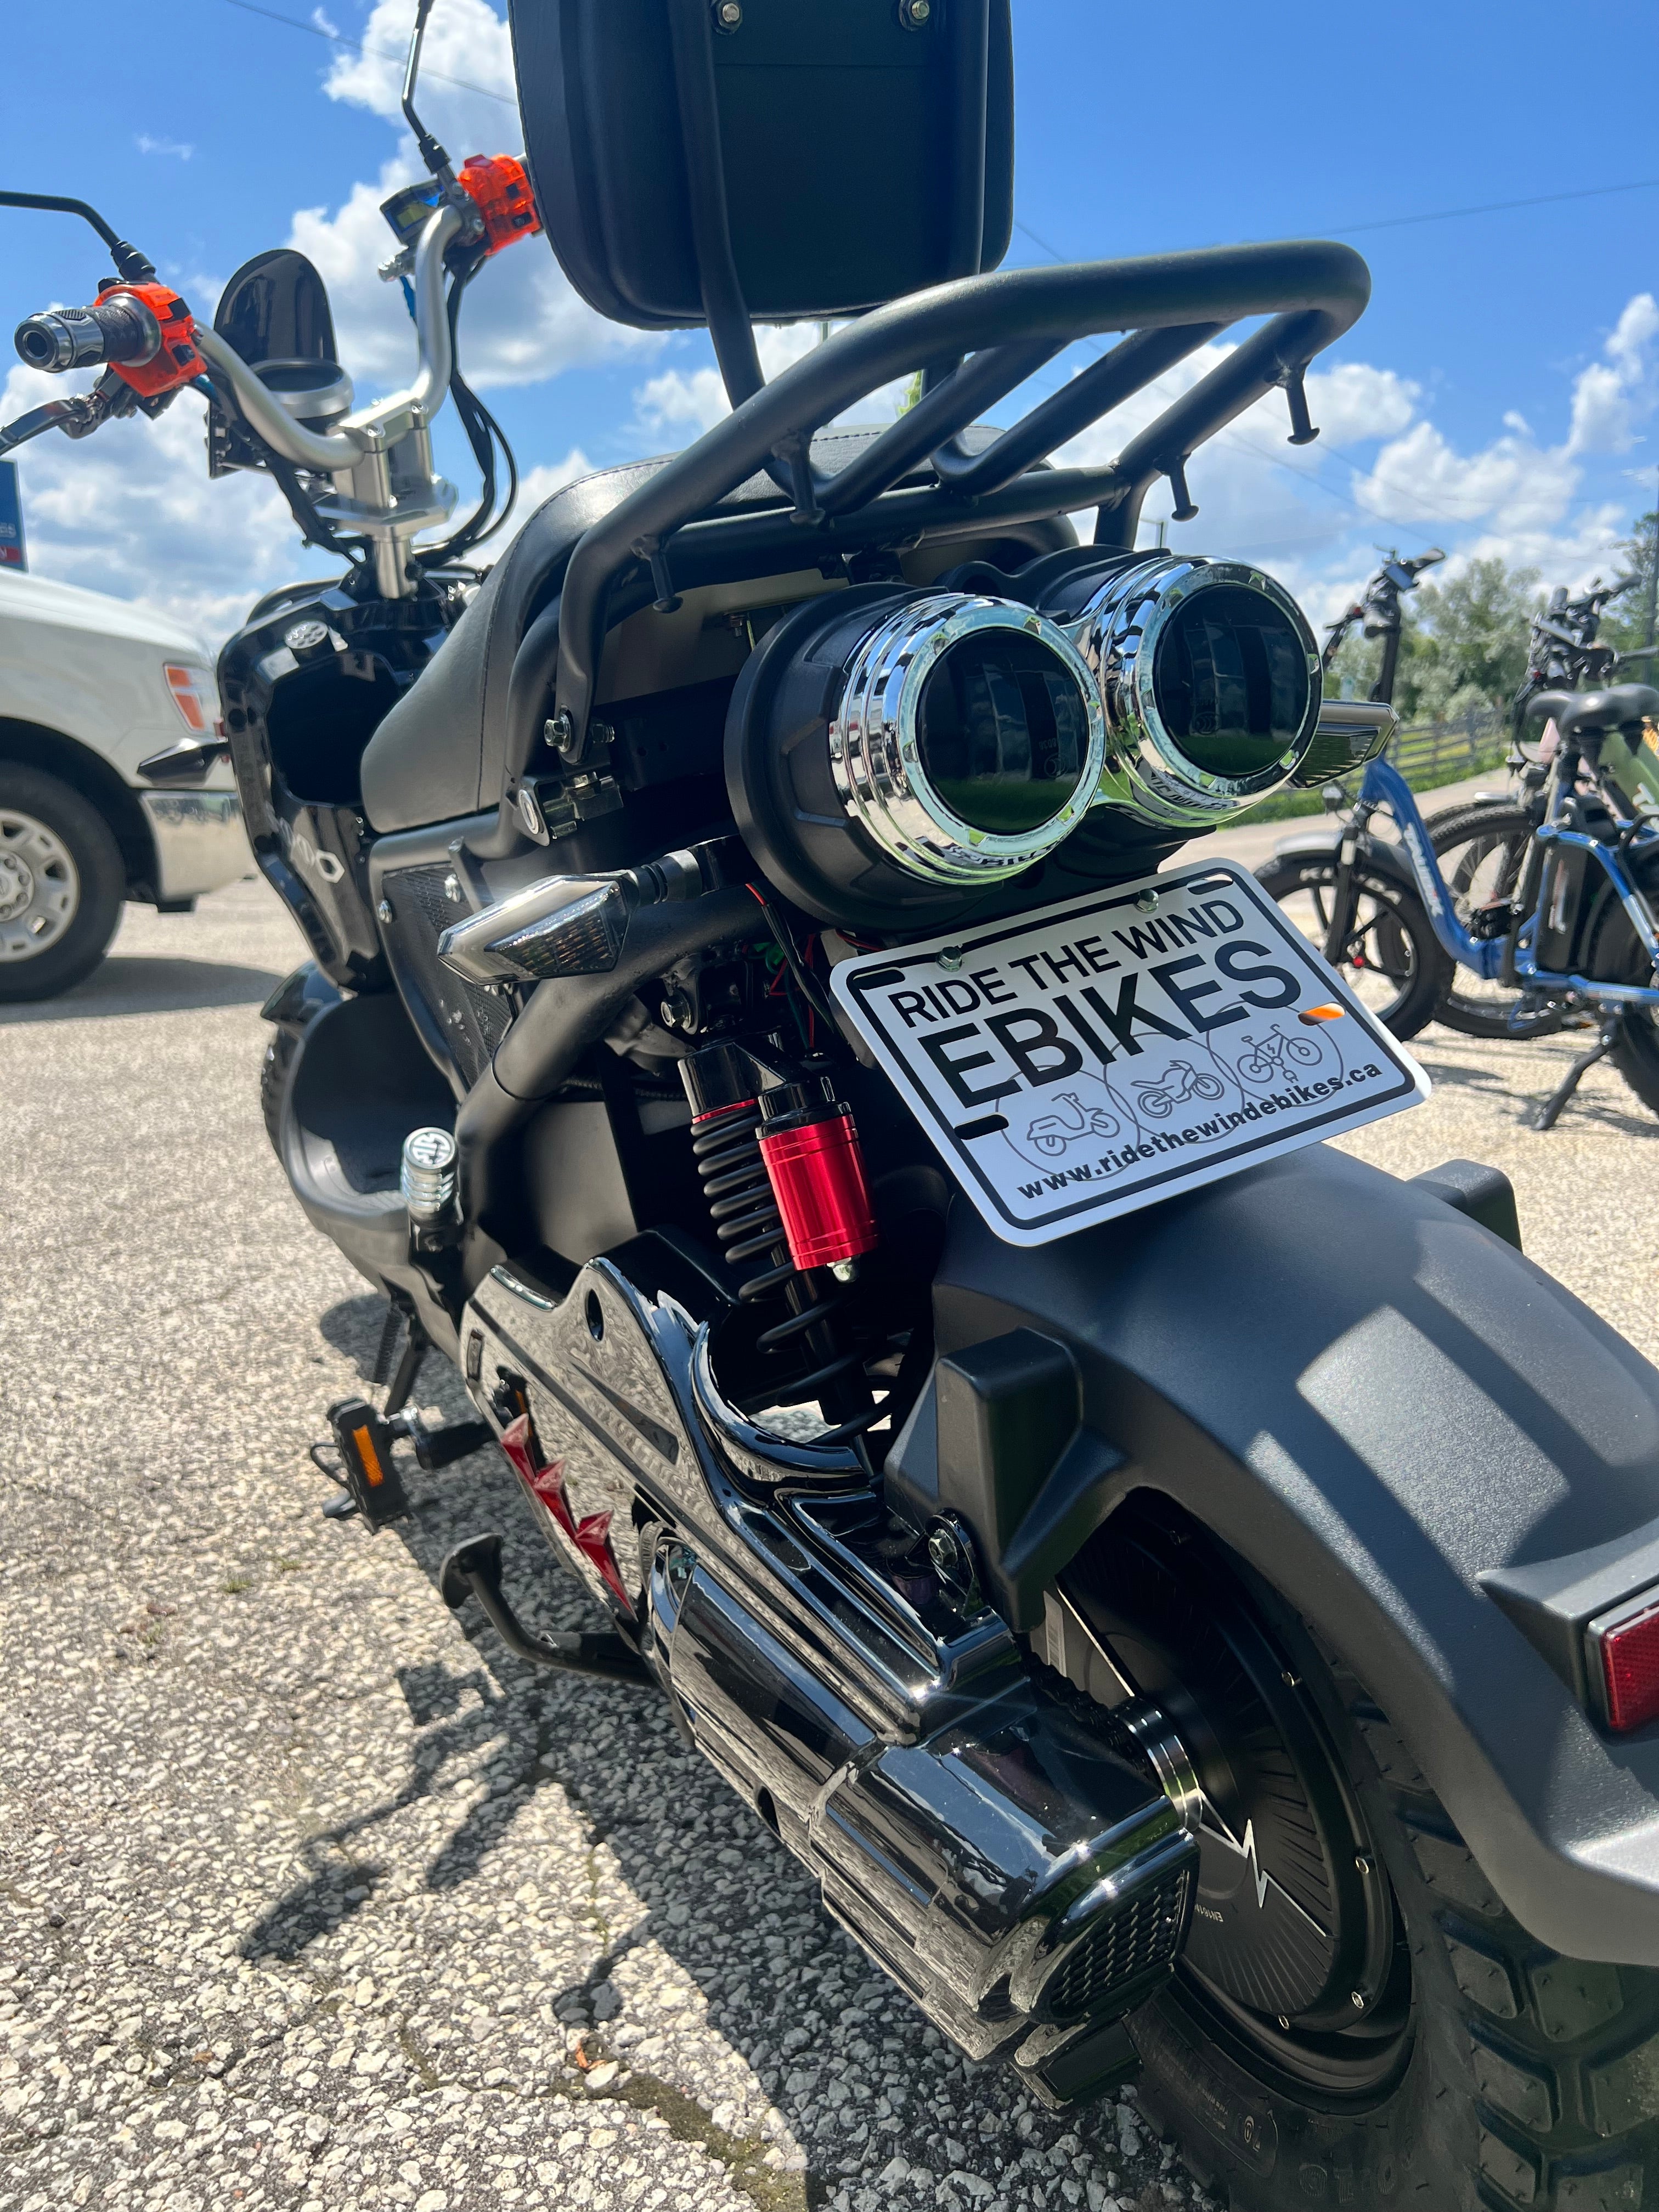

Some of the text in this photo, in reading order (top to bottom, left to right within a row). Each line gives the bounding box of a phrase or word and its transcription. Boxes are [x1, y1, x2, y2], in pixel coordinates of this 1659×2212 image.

[888, 900, 1244, 1028] RIDE THE WIND
[917, 940, 1301, 1109] EBIKES
[1017, 1063, 1383, 1200] www.ridethewindebikes.ca
